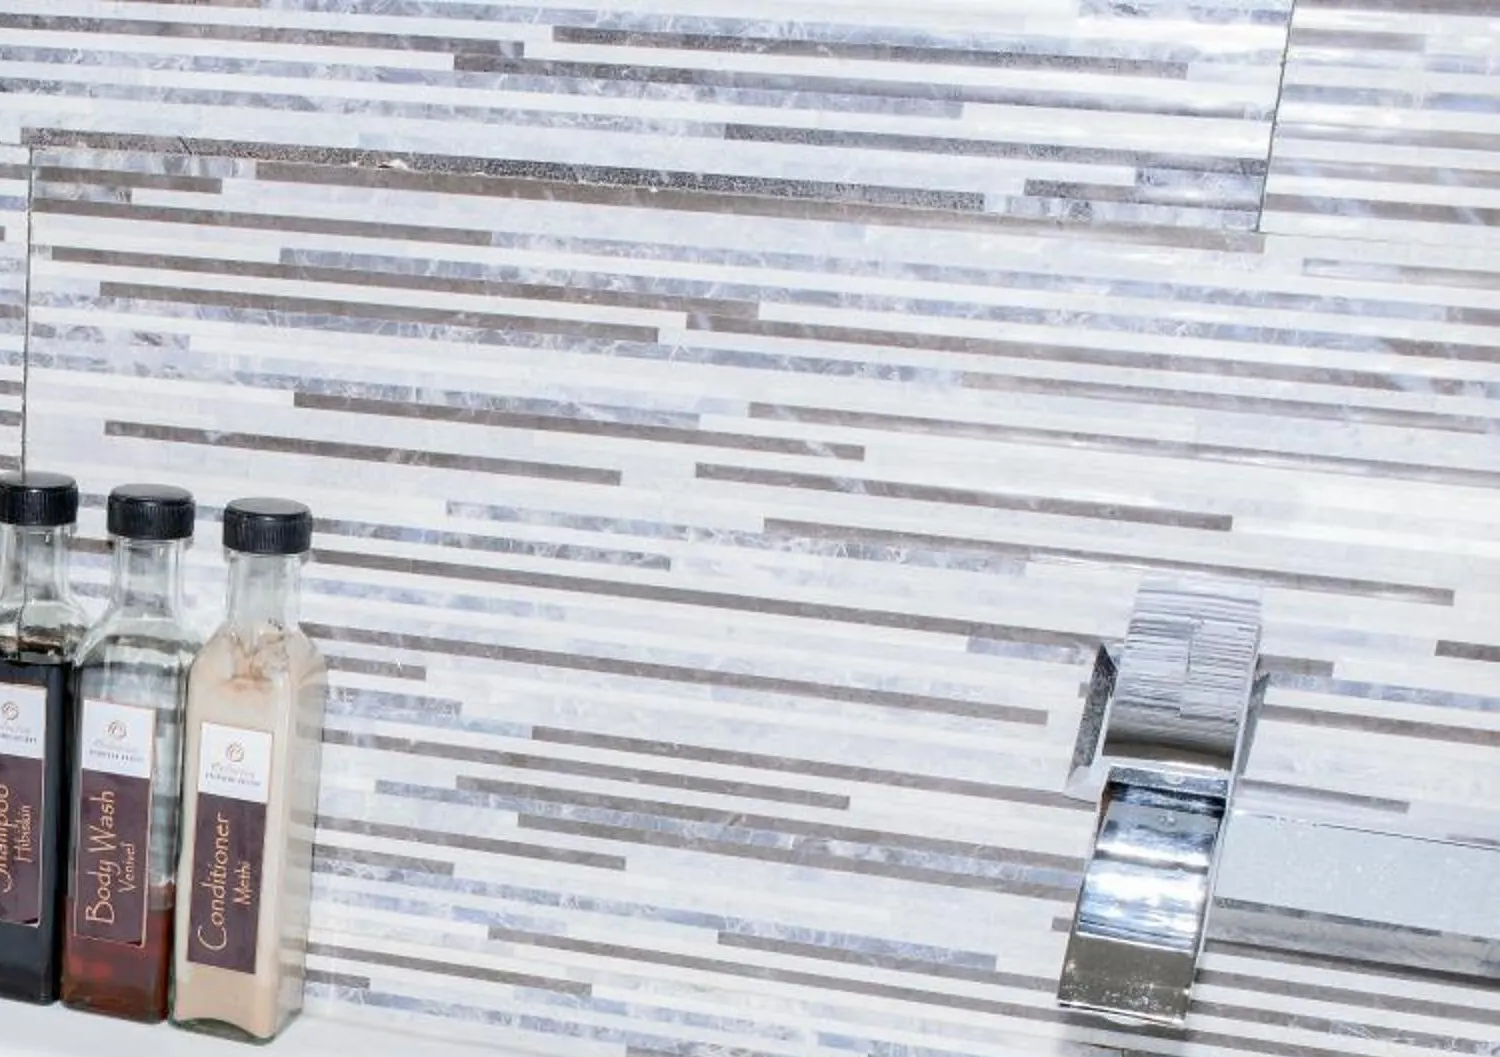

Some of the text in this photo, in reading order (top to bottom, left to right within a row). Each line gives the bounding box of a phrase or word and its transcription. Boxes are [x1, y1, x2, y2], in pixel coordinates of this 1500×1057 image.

[87, 790, 117, 853] Wash
[85, 857, 121, 925] Body
[197, 811, 229, 951] Conditioner
